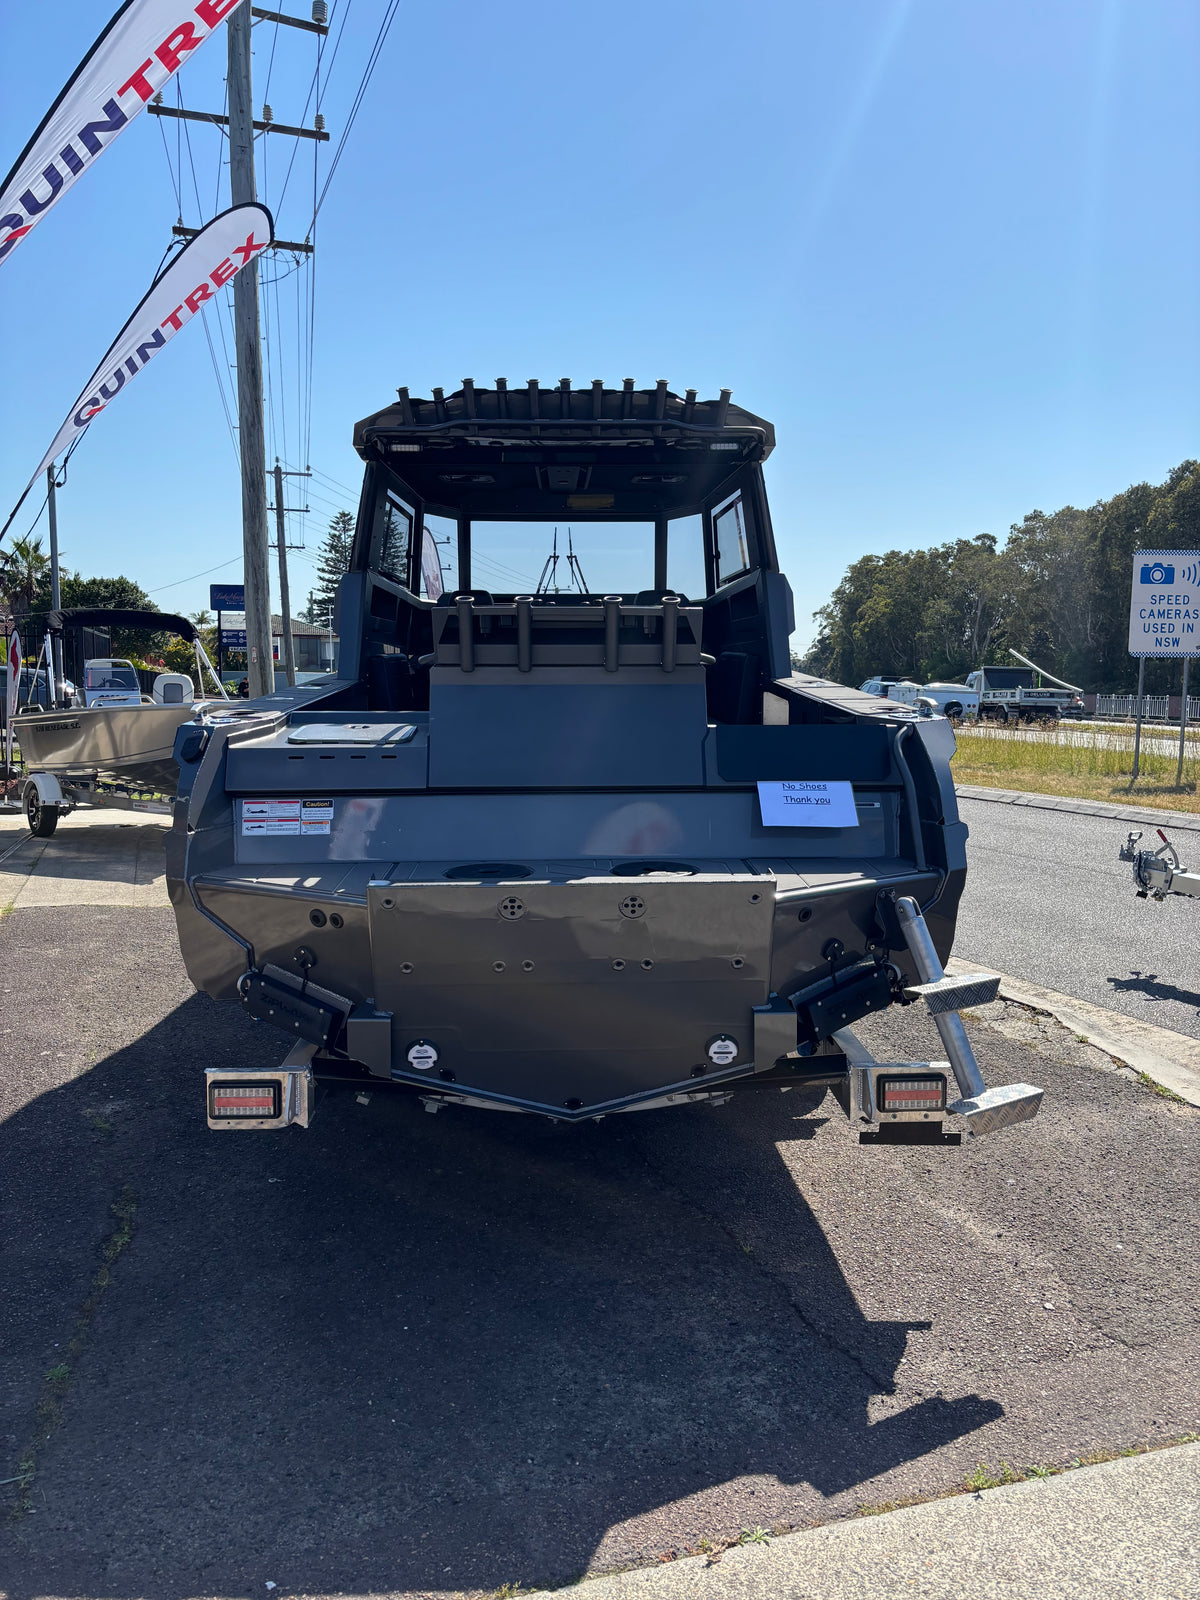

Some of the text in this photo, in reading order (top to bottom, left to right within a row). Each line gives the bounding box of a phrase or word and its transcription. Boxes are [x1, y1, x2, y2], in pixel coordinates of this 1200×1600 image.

[73, 231, 267, 428] QUINTREX
[1150, 594, 1190, 606] SPEED
[1139, 608, 1199, 620] CAMERAS
[1143, 622, 1194, 634] USED IN
[1154, 637, 1181, 648] NSW
[799, 782, 827, 790] Shoes
[783, 795, 831, 805] Thank you
